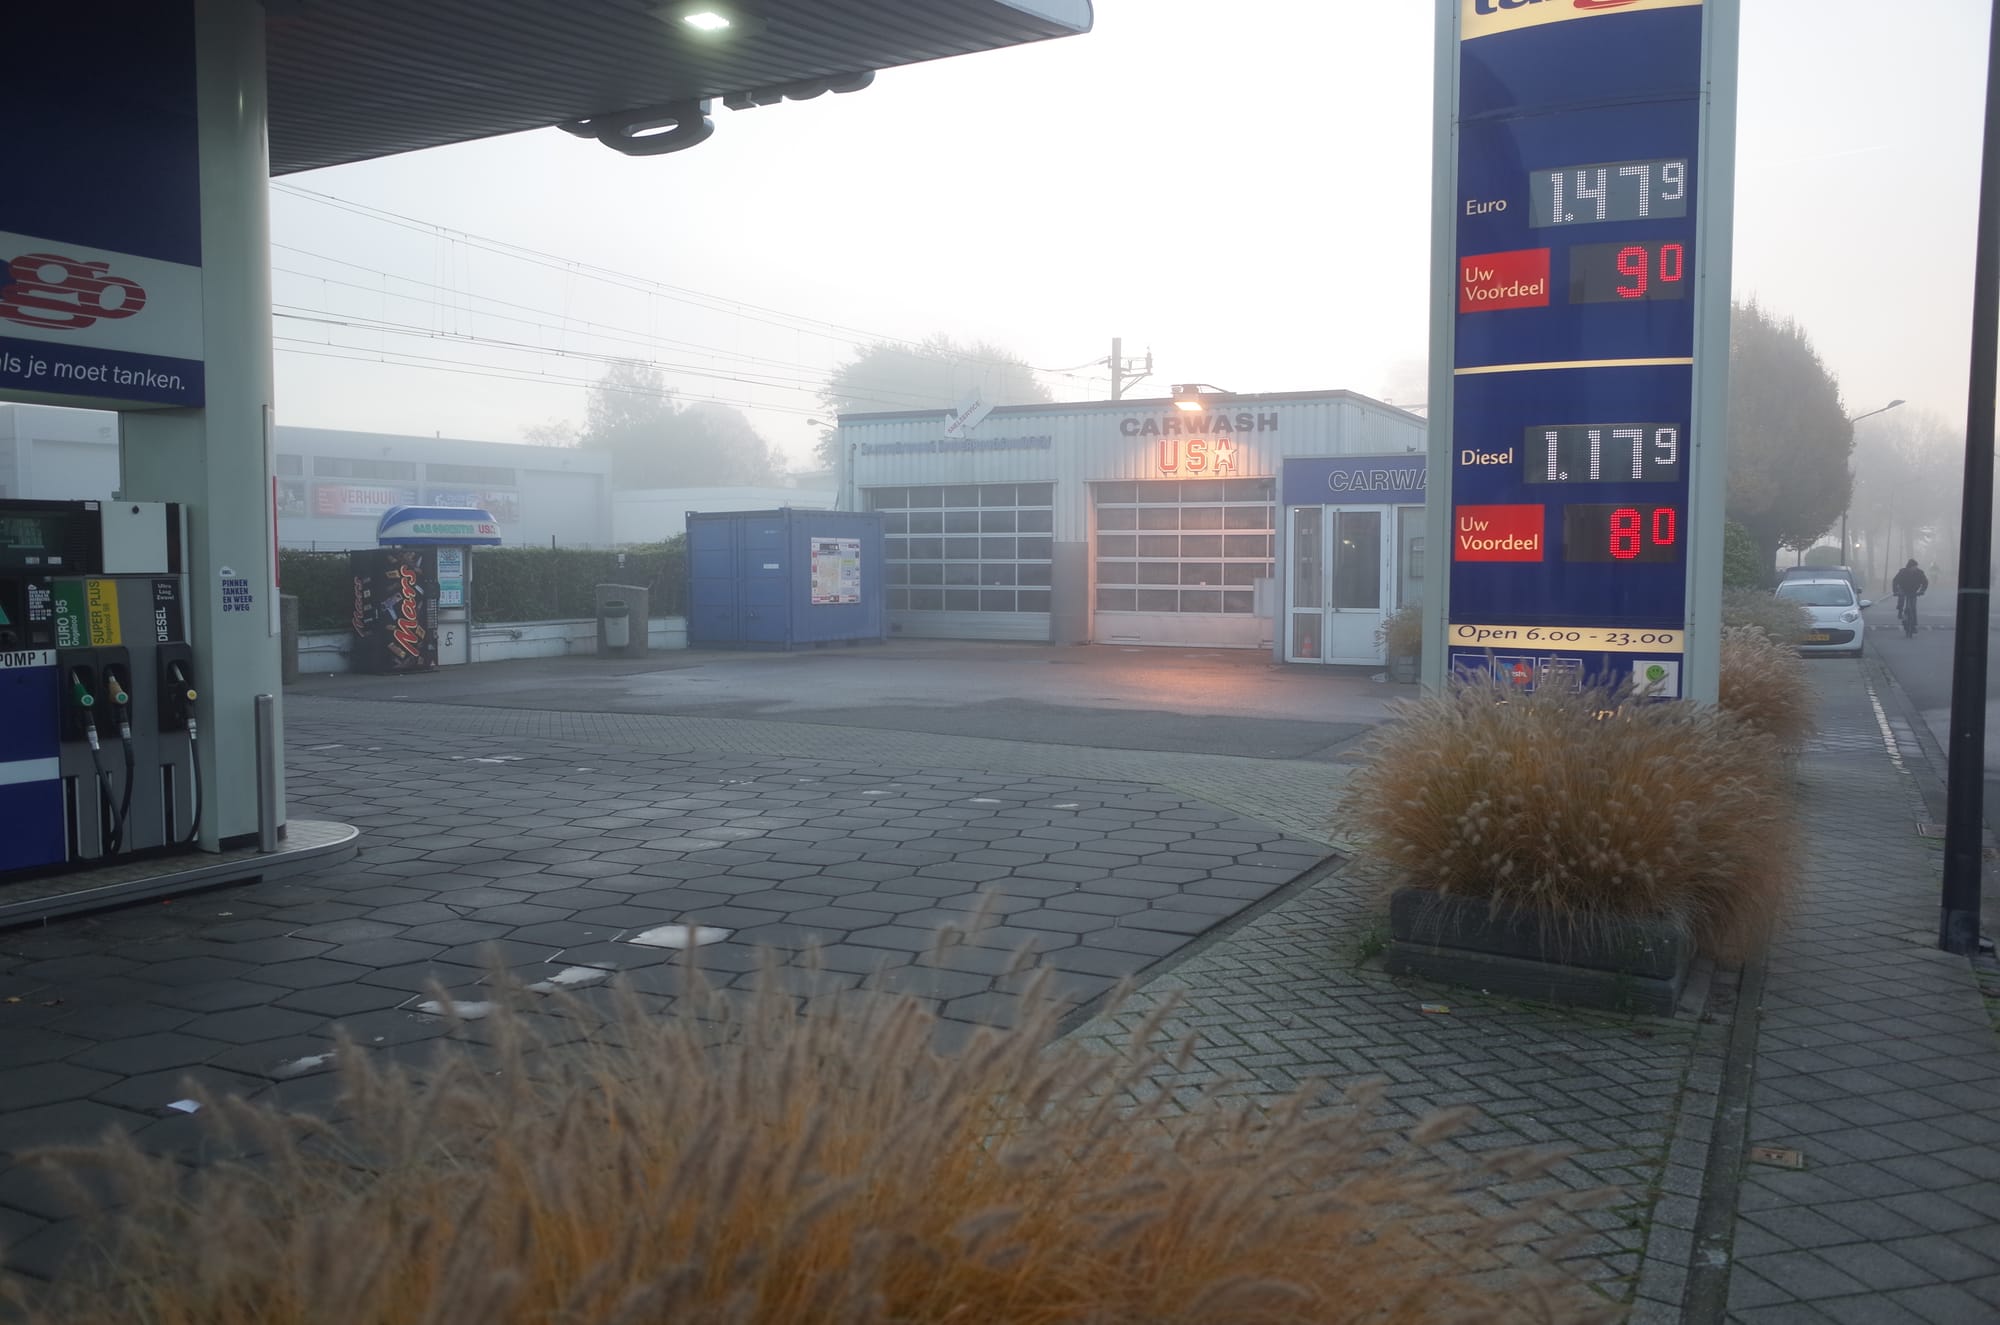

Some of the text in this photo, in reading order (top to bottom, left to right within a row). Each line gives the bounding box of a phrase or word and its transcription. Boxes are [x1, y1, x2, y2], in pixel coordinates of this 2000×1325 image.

[1466, 199, 1507, 215] Euro
[1465, 266, 1494, 283] Uw
[1465, 279, 1544, 300] Voordeel
[0, 352, 186, 390] ls je moet tanken.
[1119, 411, 1278, 437] CARWASH
[1157, 437, 1238, 473] USA
[1461, 447, 1514, 466] Diesel
[1460, 516, 1489, 532] Uw
[1460, 533, 1539, 552] Voordeel
[222, 579, 248, 587] PINNEN
[222, 587, 248, 595] TANKEN
[223, 595, 253, 603] EN WEER
[223, 603, 250, 612] OP WEG
[88, 580, 105, 645] SUPER PLUS
[393, 564, 419, 657] Mars
[55, 599, 71, 647] EURO 95
[156, 607, 169, 642] DIESEL
[1457, 624, 1517, 643] Open
[1526, 628, 1580, 642] 6.00
[1605, 631, 1673, 646] 23.00
[42, 651, 47, 665] 1
